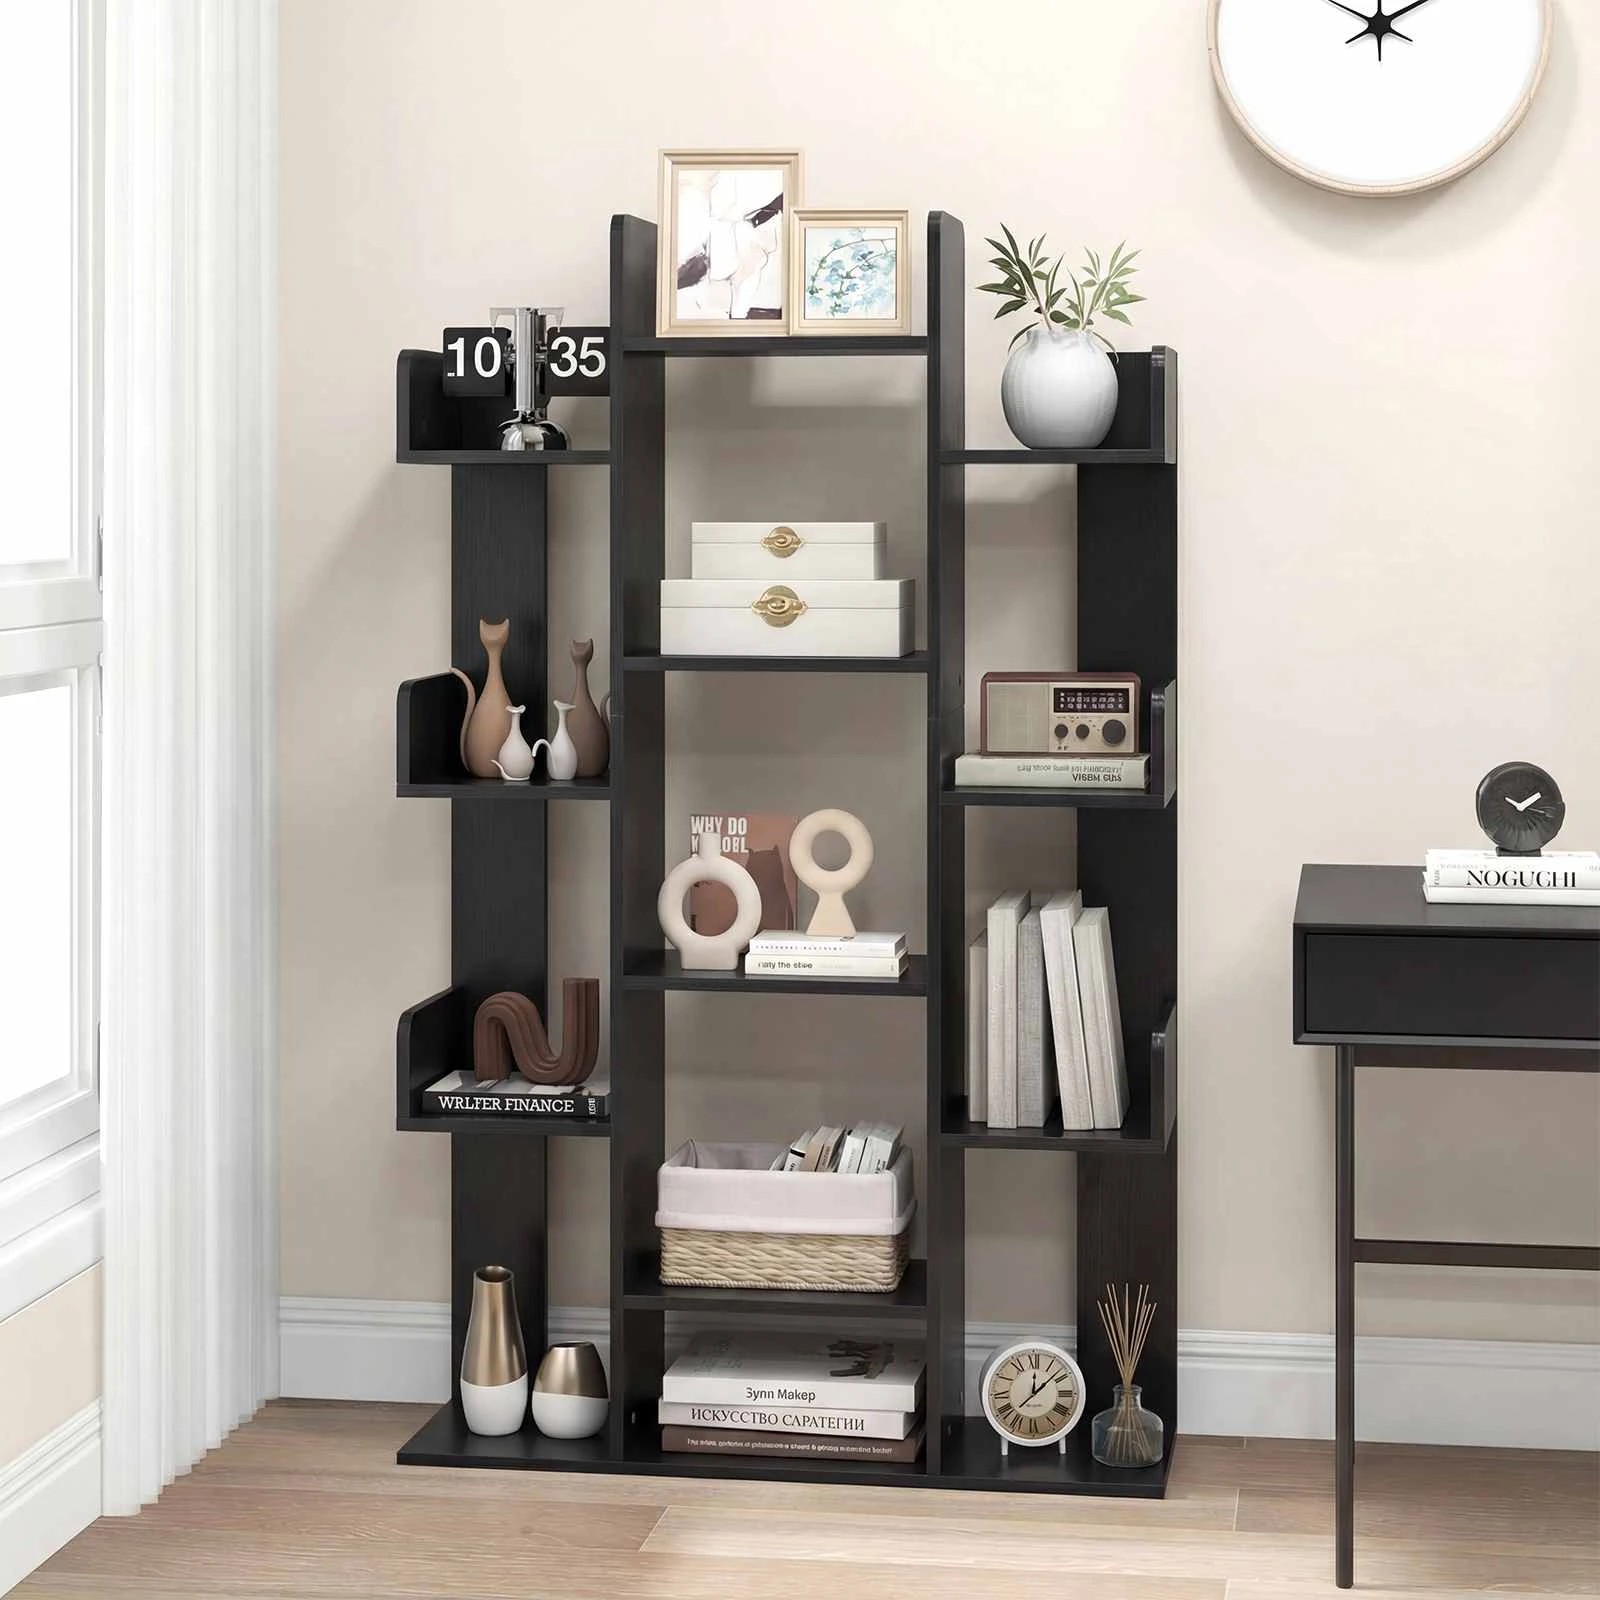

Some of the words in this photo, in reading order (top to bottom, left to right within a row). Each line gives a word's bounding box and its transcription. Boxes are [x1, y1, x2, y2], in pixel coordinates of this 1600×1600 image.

[447, 336, 501, 378] 10
[550, 336, 606, 378] 35
[691, 815, 723, 834] WHY
[727, 817, 748, 835] DO
[504, 1098, 575, 1113] FINANCE
[691, 1407, 779, 1426] ИСКУССТВО
